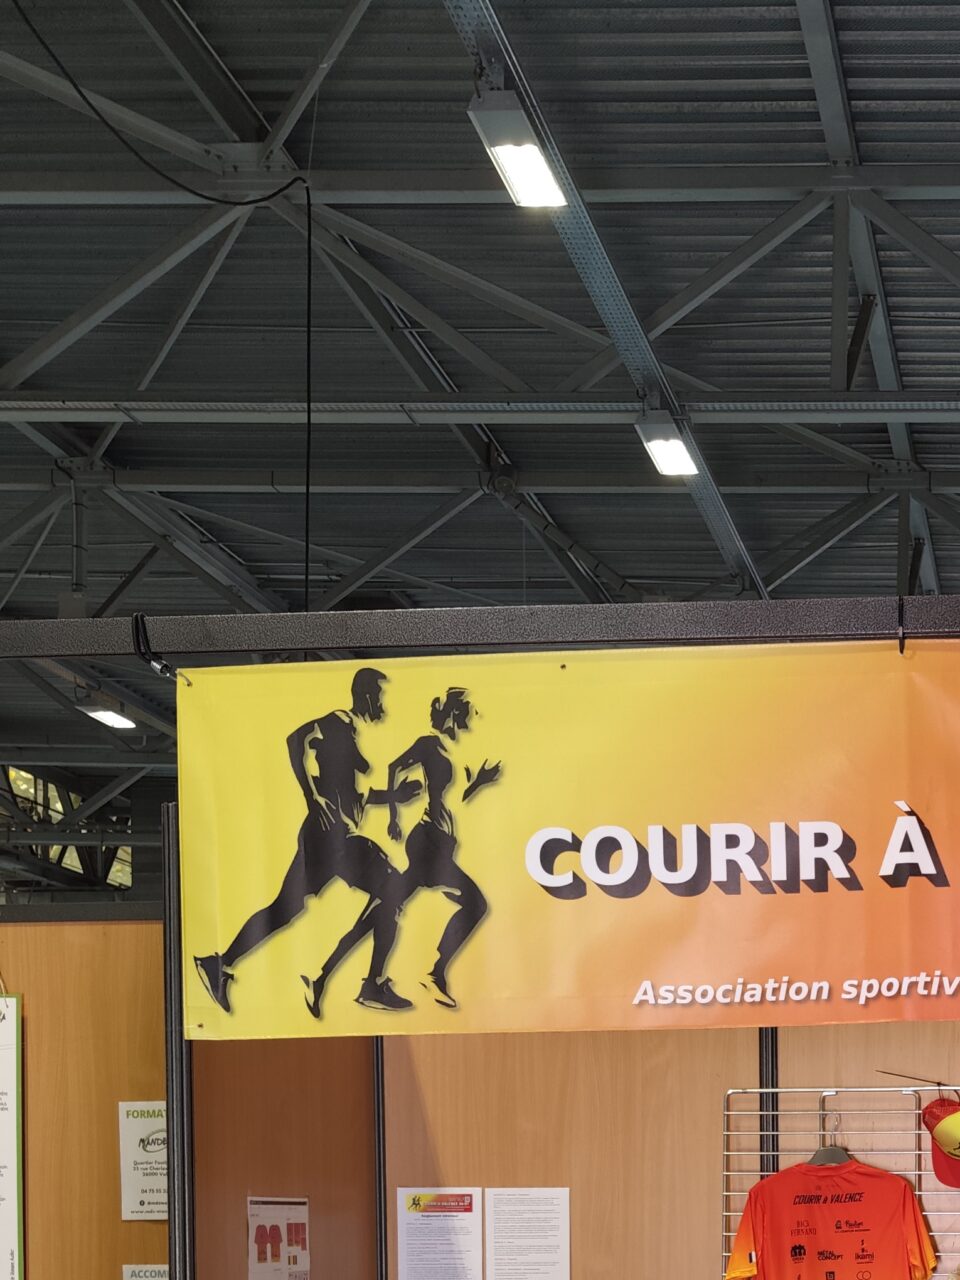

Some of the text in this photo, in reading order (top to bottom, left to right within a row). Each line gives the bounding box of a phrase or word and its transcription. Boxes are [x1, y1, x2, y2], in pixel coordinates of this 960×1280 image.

[525, 820, 862, 899] COURIR
[878, 801, 948, 888] À
[632, 975, 830, 1005] Association
[126, 1109, 167, 1119] FORMA
[793, 1194, 822, 1205] COURIR
[830, 1192, 865, 1204] VALENCE
